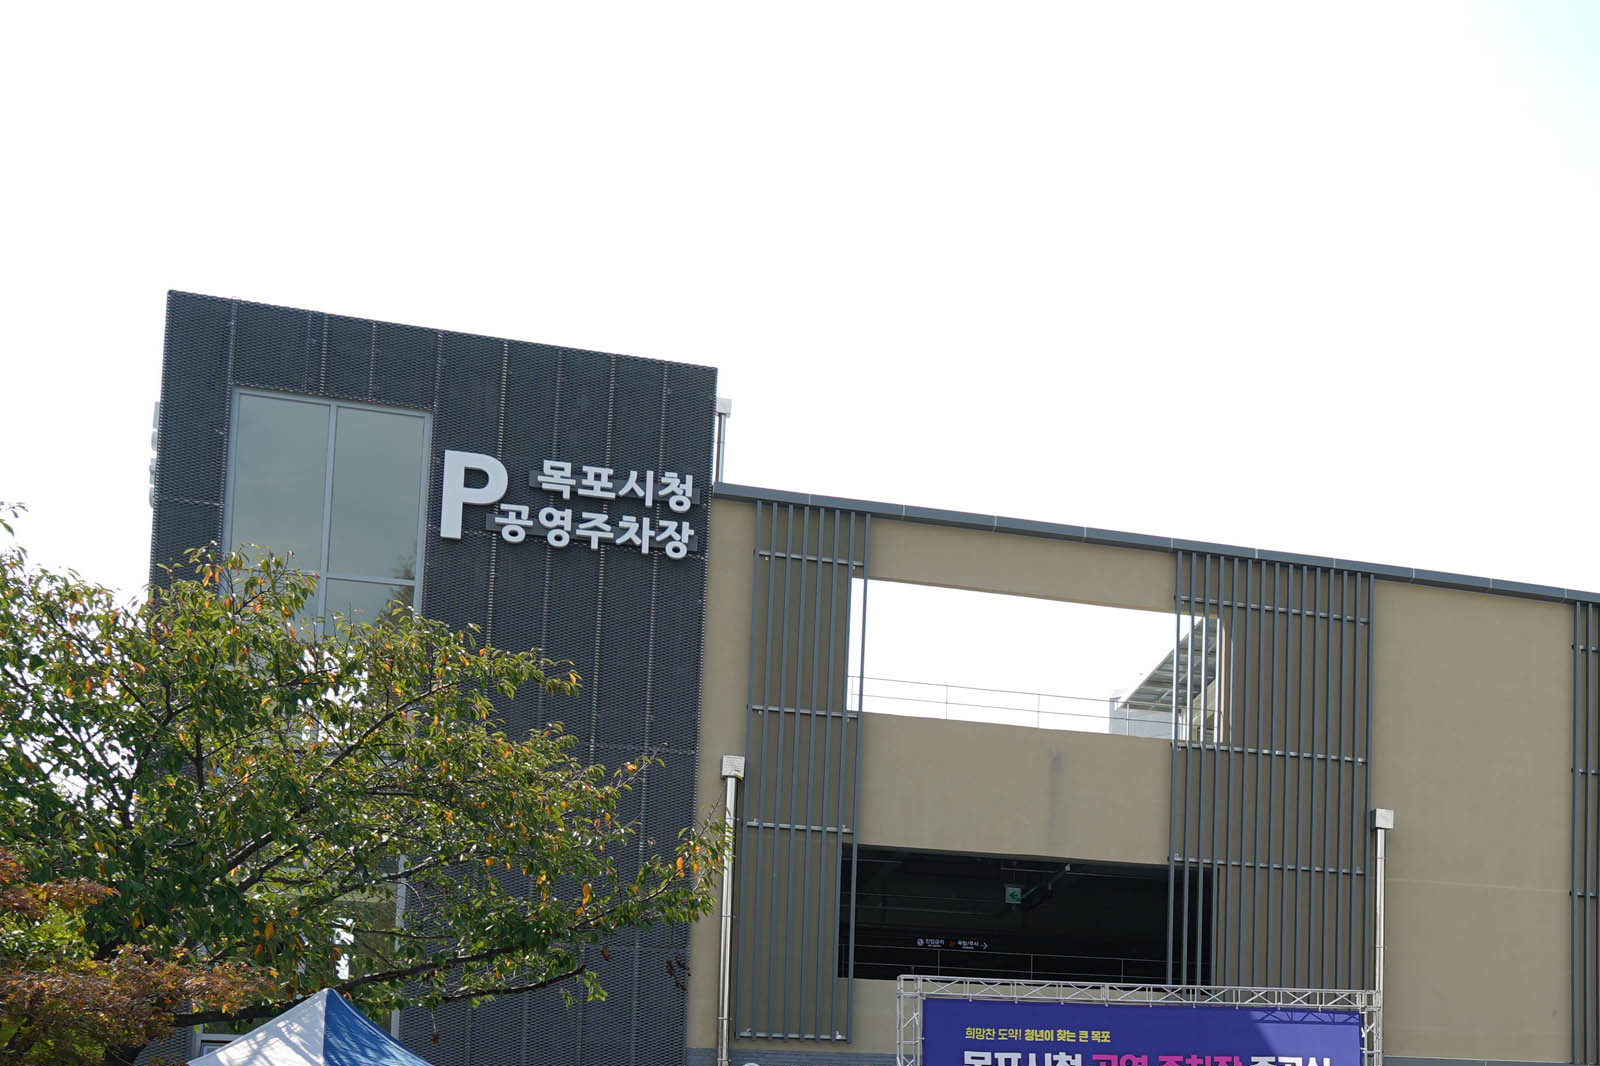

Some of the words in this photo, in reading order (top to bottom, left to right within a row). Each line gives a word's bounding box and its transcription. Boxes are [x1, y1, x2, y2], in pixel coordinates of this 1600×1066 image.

[440, 449, 509, 540] P
[537, 459, 695, 514] 목포시청
[494, 503, 695, 560] 공영주차장
[965, 1027, 996, 1040] 희망찬
[998, 1028, 1022, 1041] 도약!
[1024, 1029, 1054, 1042] 청년이
[1057, 1029, 1076, 1042] 찾는
[1079, 1030, 1089, 1043] 큰
[1091, 1031, 1111, 1043] 목포
